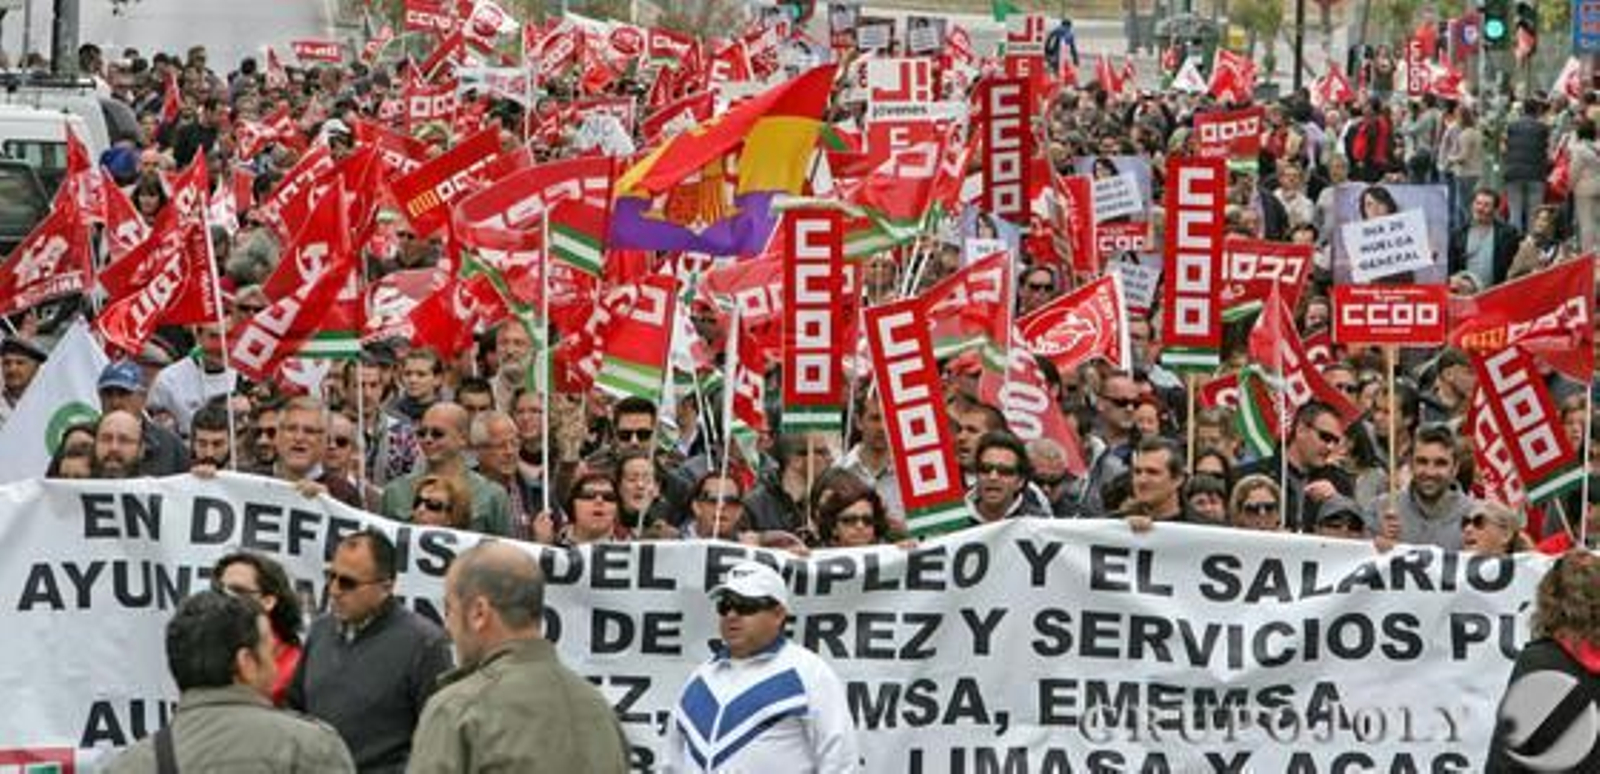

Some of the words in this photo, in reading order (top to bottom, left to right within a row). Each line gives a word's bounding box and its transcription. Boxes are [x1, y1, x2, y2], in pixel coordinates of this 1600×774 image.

[990, 83, 1021, 213] CCOO
[794, 218, 832, 394] CCOO
[1177, 167, 1214, 336] CCOO
[1342, 303, 1439, 326] CCOO
[876, 311, 949, 497] CCOO
[83, 493, 162, 541] EN
[541, 544, 677, 590] DEL
[1017, 539, 1063, 588] Y
[1089, 544, 1174, 598] EL
[1199, 549, 1516, 604] SALARIO
[590, 608, 684, 654] DE
[960, 608, 1008, 656] Y
[1032, 609, 1424, 669] SERVICIOS
